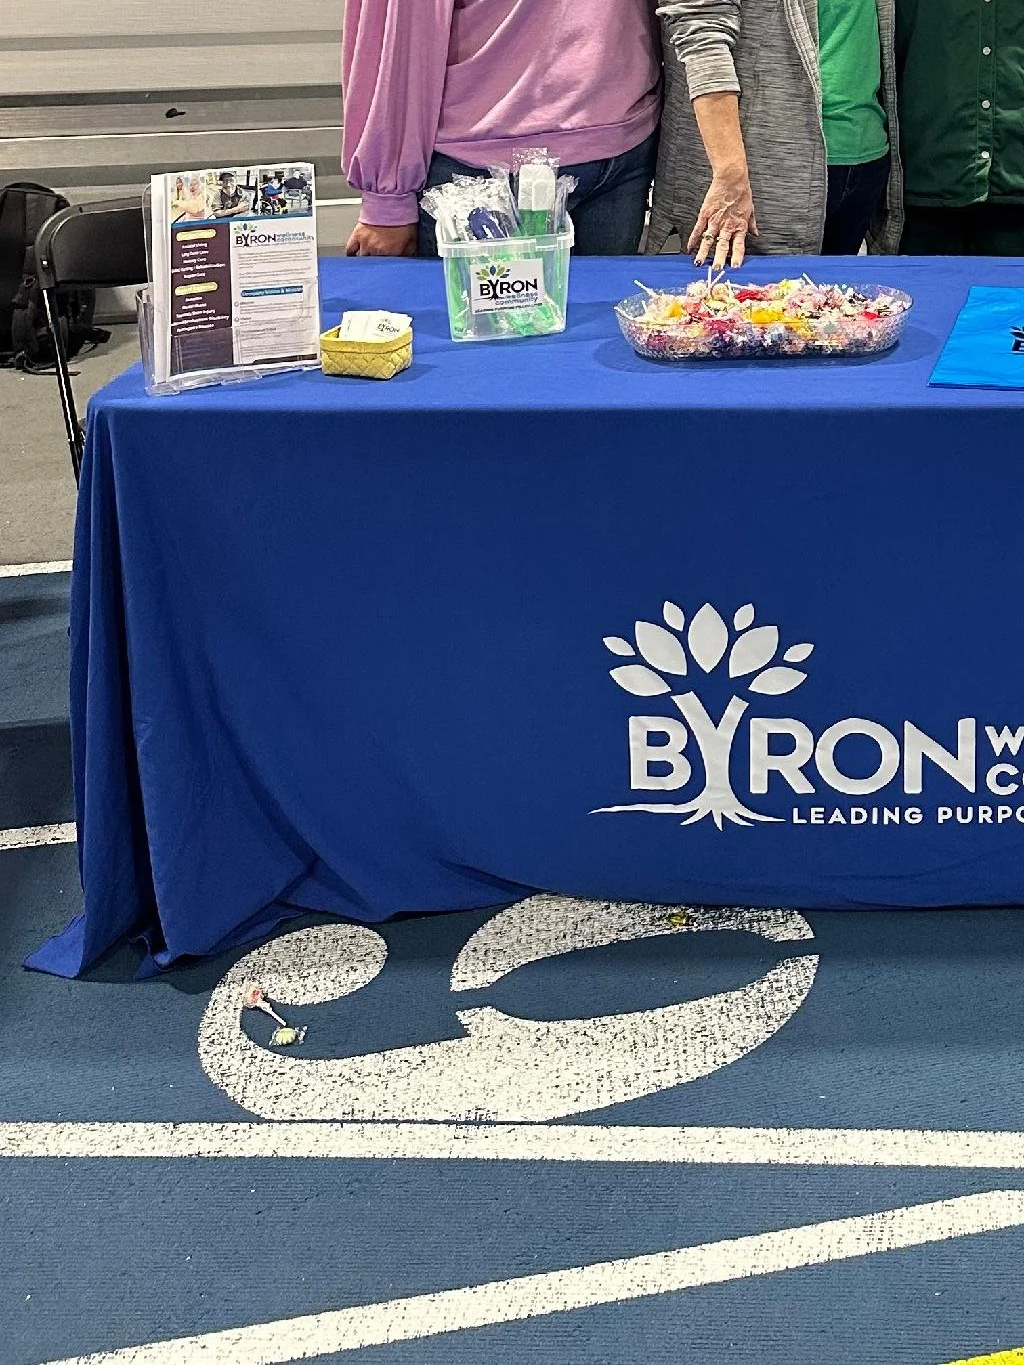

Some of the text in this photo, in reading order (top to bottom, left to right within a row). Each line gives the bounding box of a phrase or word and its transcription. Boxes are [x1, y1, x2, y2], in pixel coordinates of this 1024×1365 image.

[235, 234, 277, 246] BYRON
[479, 278, 538, 299] BYRON
[628, 692, 977, 803] BYRON
[791, 806, 924, 825] LEADING
